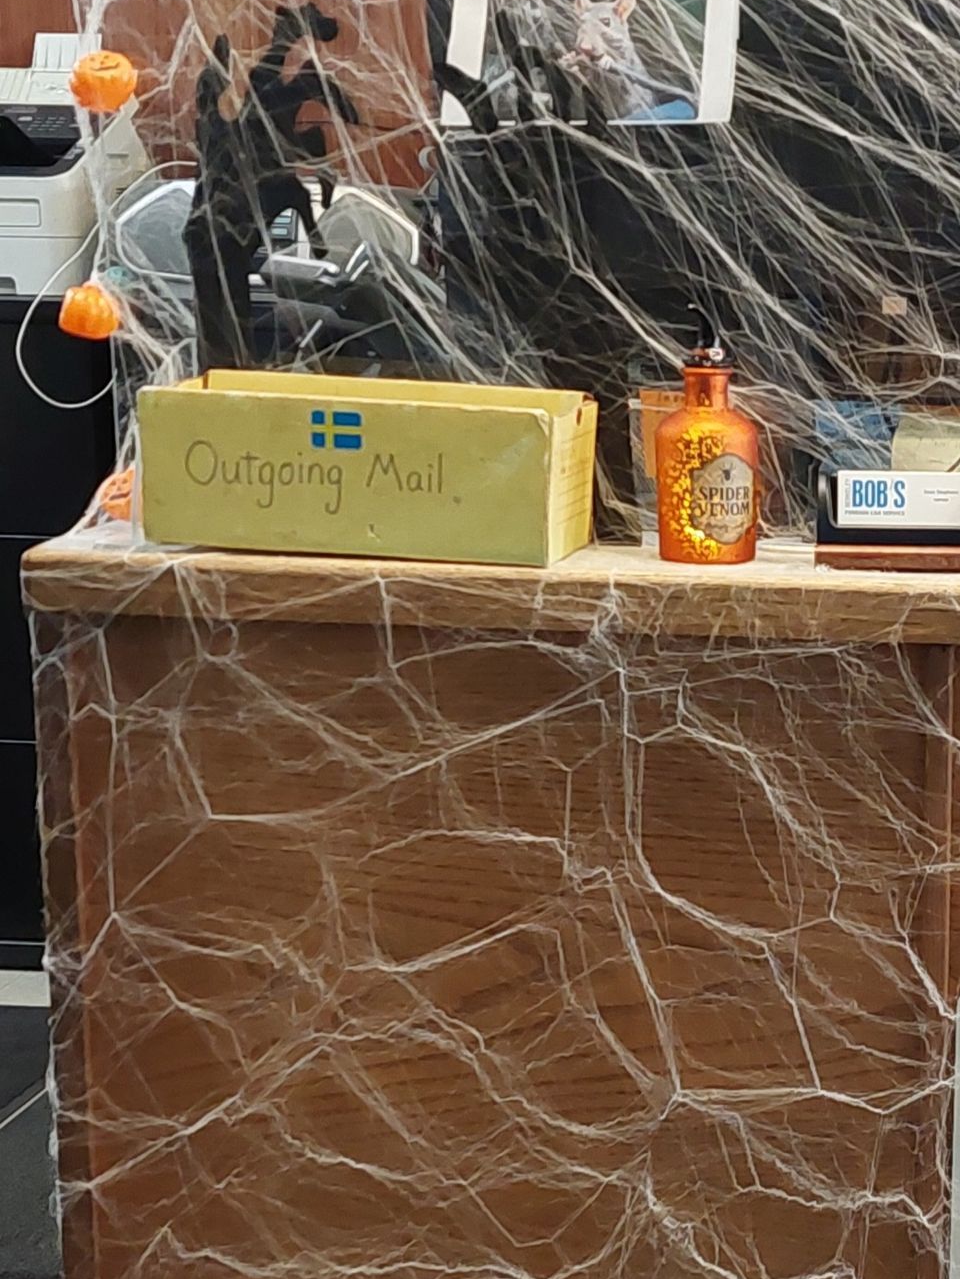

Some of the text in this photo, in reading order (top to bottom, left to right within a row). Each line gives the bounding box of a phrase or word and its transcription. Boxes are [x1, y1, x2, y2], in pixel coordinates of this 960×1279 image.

[185, 440, 343, 515] Outgoing
[699, 486, 750, 501] SPIDER
[852, 478, 906, 508] BOB'S
[698, 502, 750, 517] VENOM
